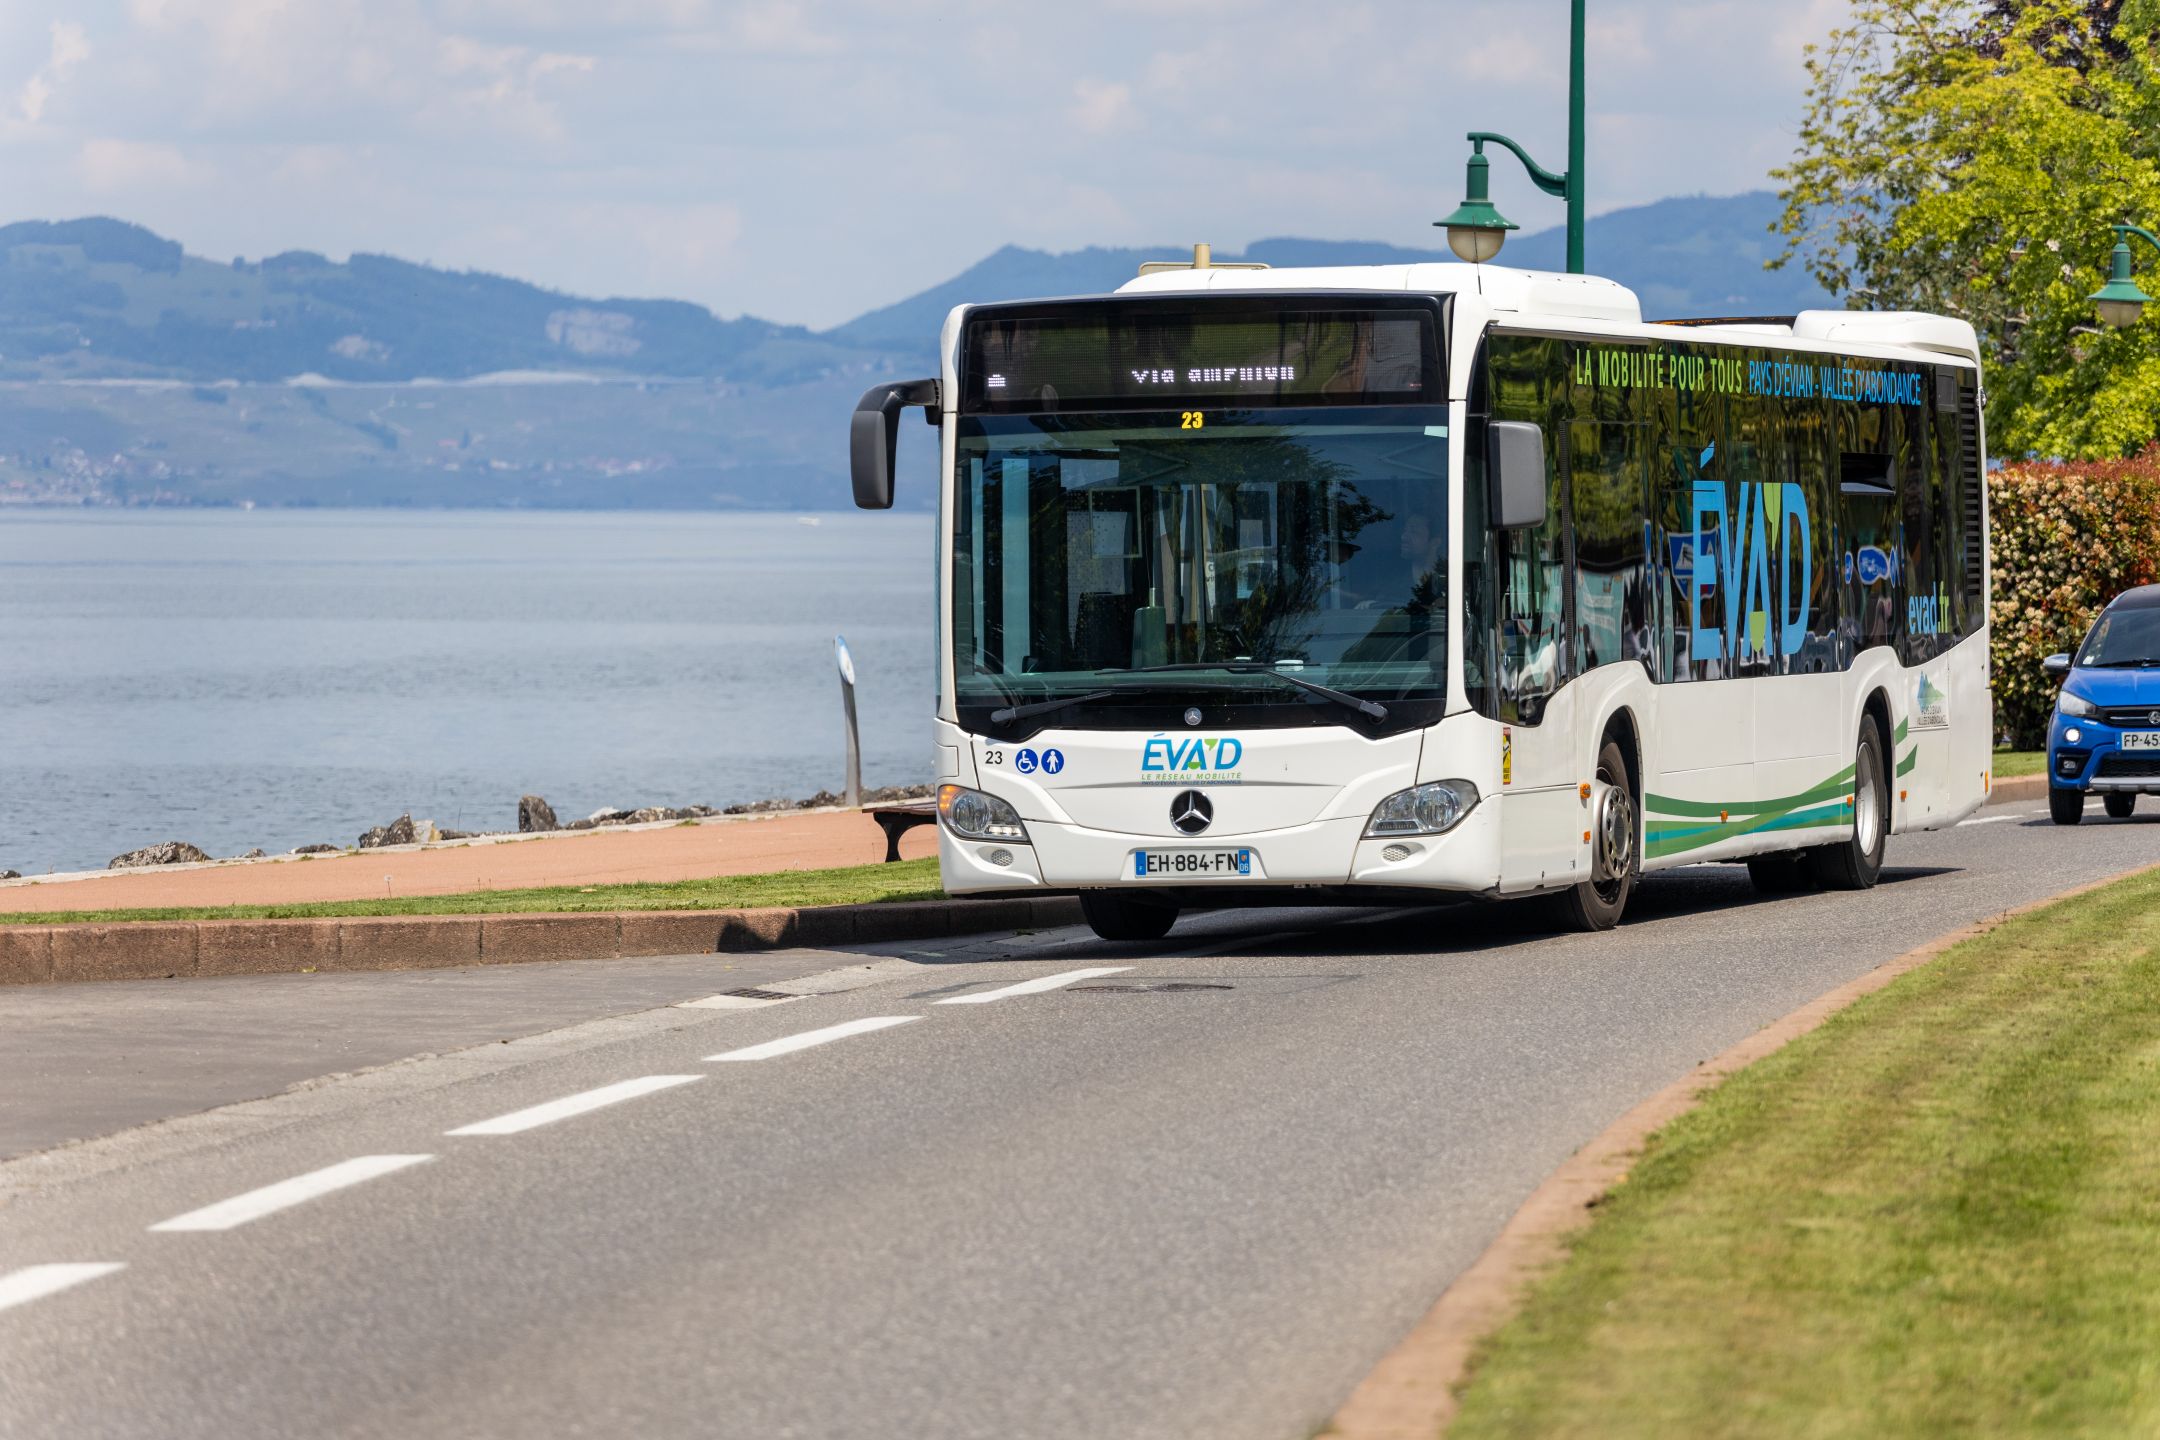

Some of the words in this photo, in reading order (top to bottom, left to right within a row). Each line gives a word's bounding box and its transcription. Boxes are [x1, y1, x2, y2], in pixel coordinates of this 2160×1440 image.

[1576, 348, 1592, 385] LA
[1599, 346, 1664, 388] MOBILITÉ
[1669, 354, 1705, 391] POUR
[1710, 358, 1742, 394] TOUS
[1749, 360, 1772, 396] PAYS
[1774, 355, 1813, 398] D'ÉVIAN
[1820, 360, 1854, 401] VALLÉE
[1856, 369, 1921, 406] D'ABONDANCE
[1181, 411, 1203, 429] 23
[1908, 580, 1950, 635] evad.fr
[2124, 734, 2160, 747] FP-45
[985, 751, 1003, 765] 23
[1196, 772, 1242, 780] MOBILITÉ
[1146, 853, 1239, 872] EH-884-FN
[1240, 863, 1249, 872] 06
